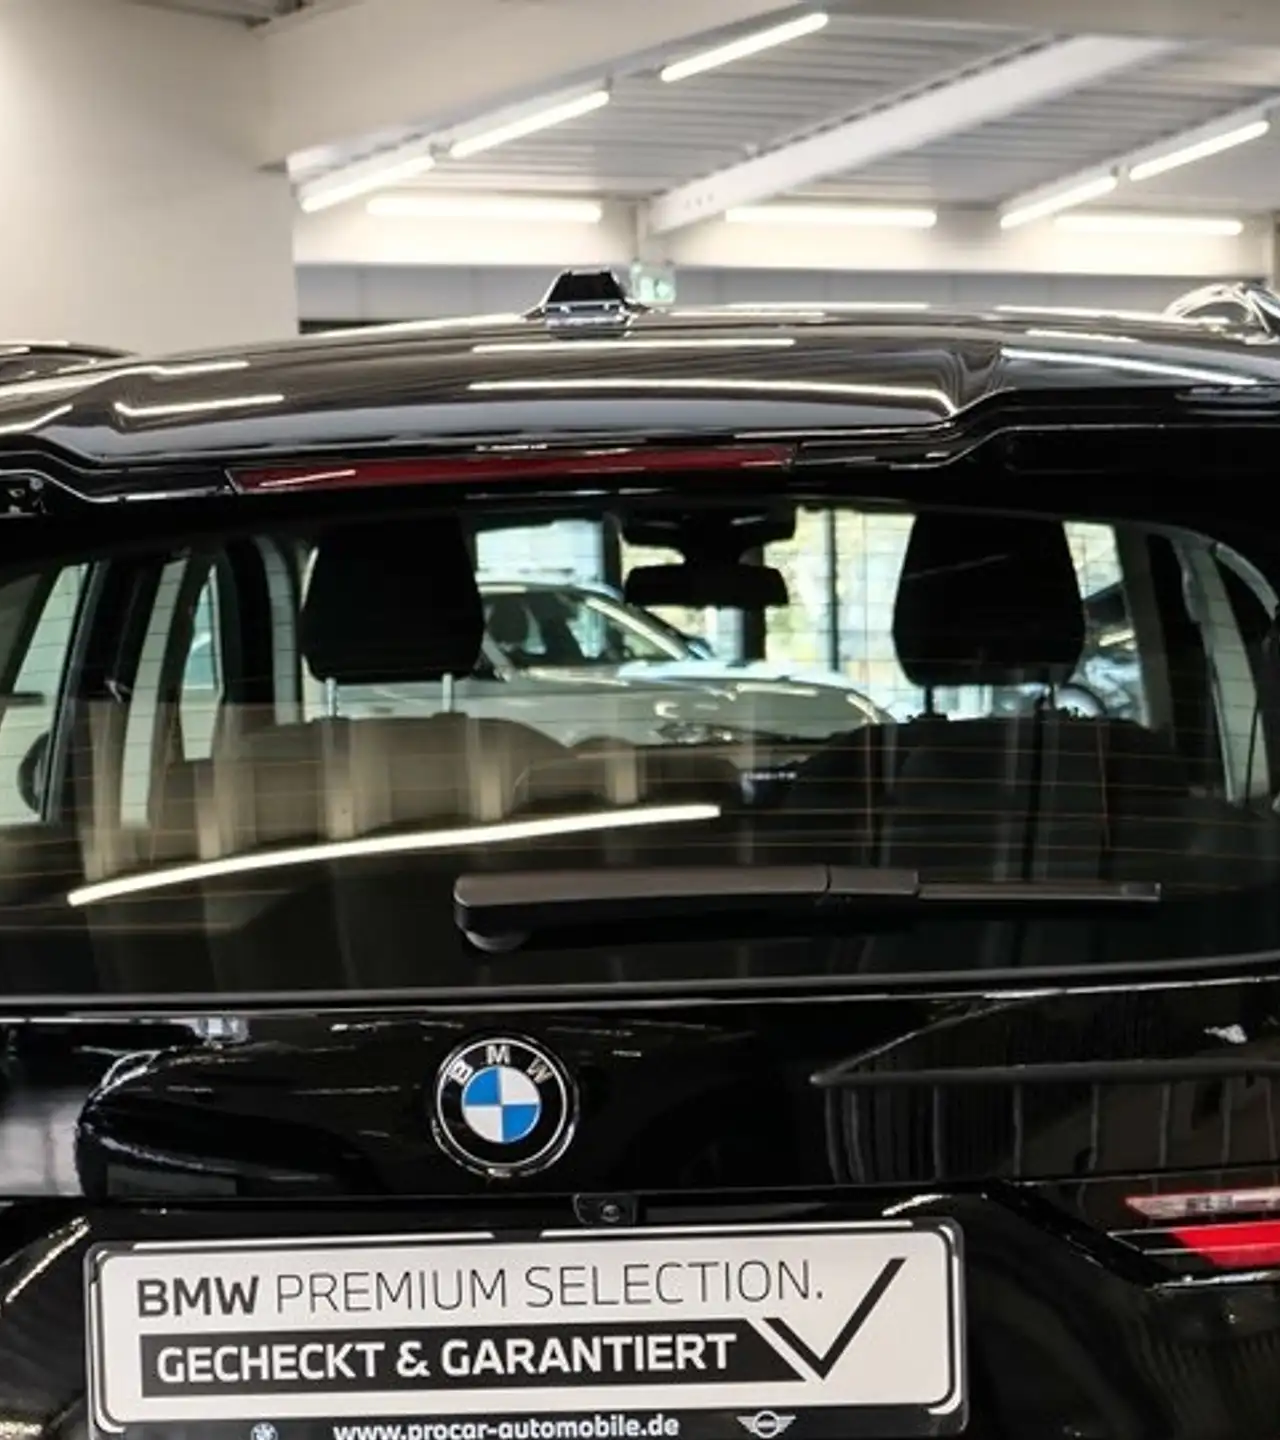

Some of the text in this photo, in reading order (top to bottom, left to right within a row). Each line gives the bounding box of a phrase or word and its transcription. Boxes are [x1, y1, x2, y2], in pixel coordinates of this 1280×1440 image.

[448, 1044, 554, 1086] BMW
[137, 1259, 824, 1318] BMW PREMIUM SELECTION.
[157, 1333, 737, 1384] GECHECKT & GARANTIERT
